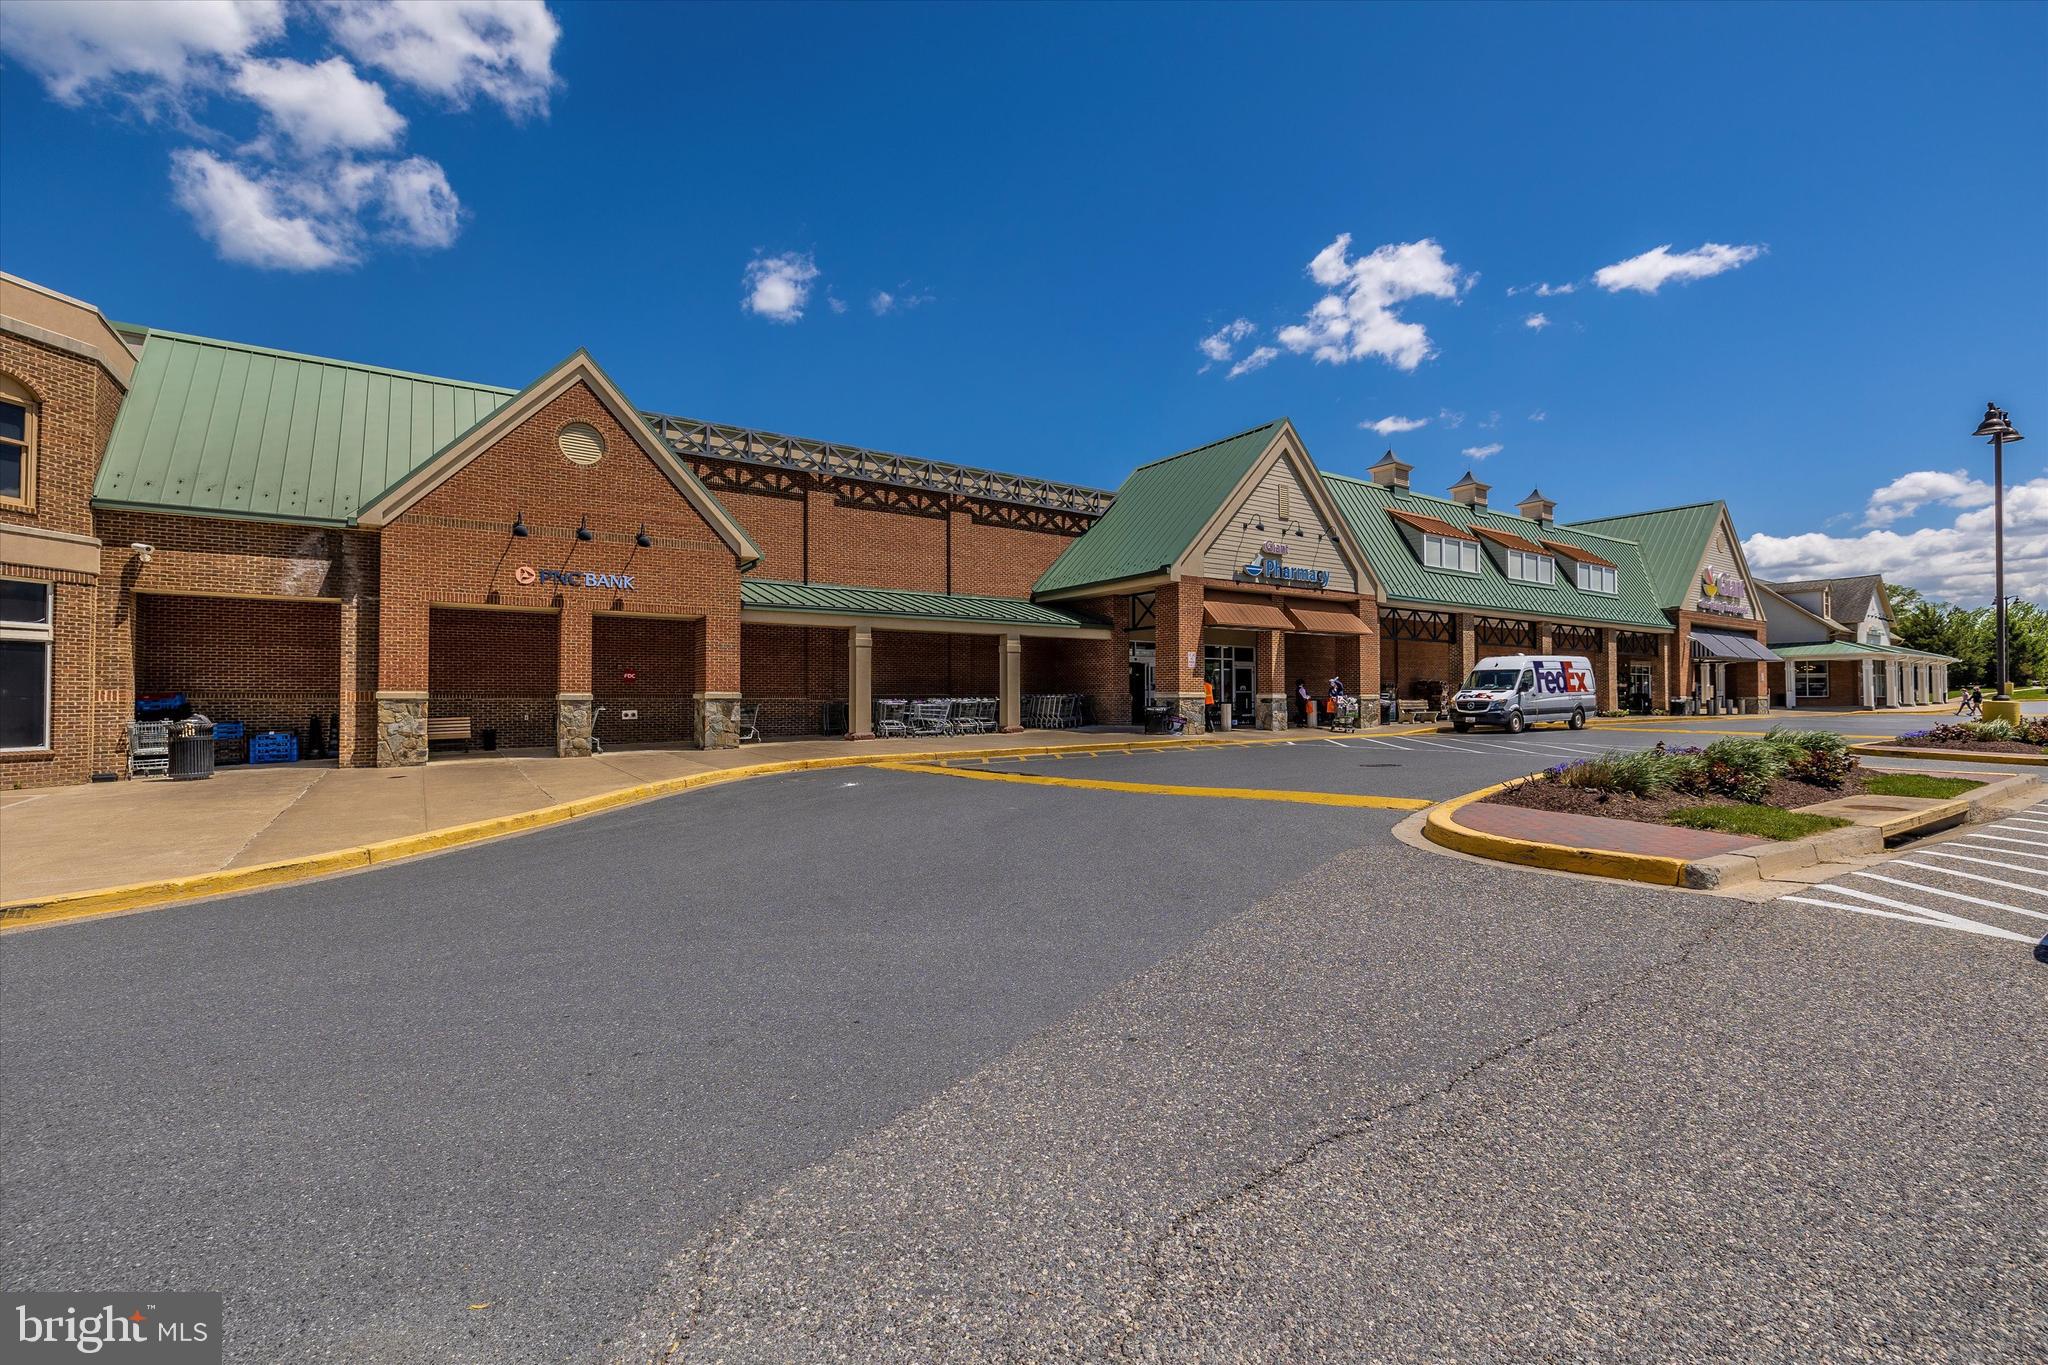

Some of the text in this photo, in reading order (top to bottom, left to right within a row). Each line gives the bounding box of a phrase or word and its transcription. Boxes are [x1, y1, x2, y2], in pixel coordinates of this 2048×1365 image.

[539, 568, 635, 590] PNC BANK
[1265, 559, 1330, 588] Pharmacy
[1533, 661, 1589, 693] FedEx
